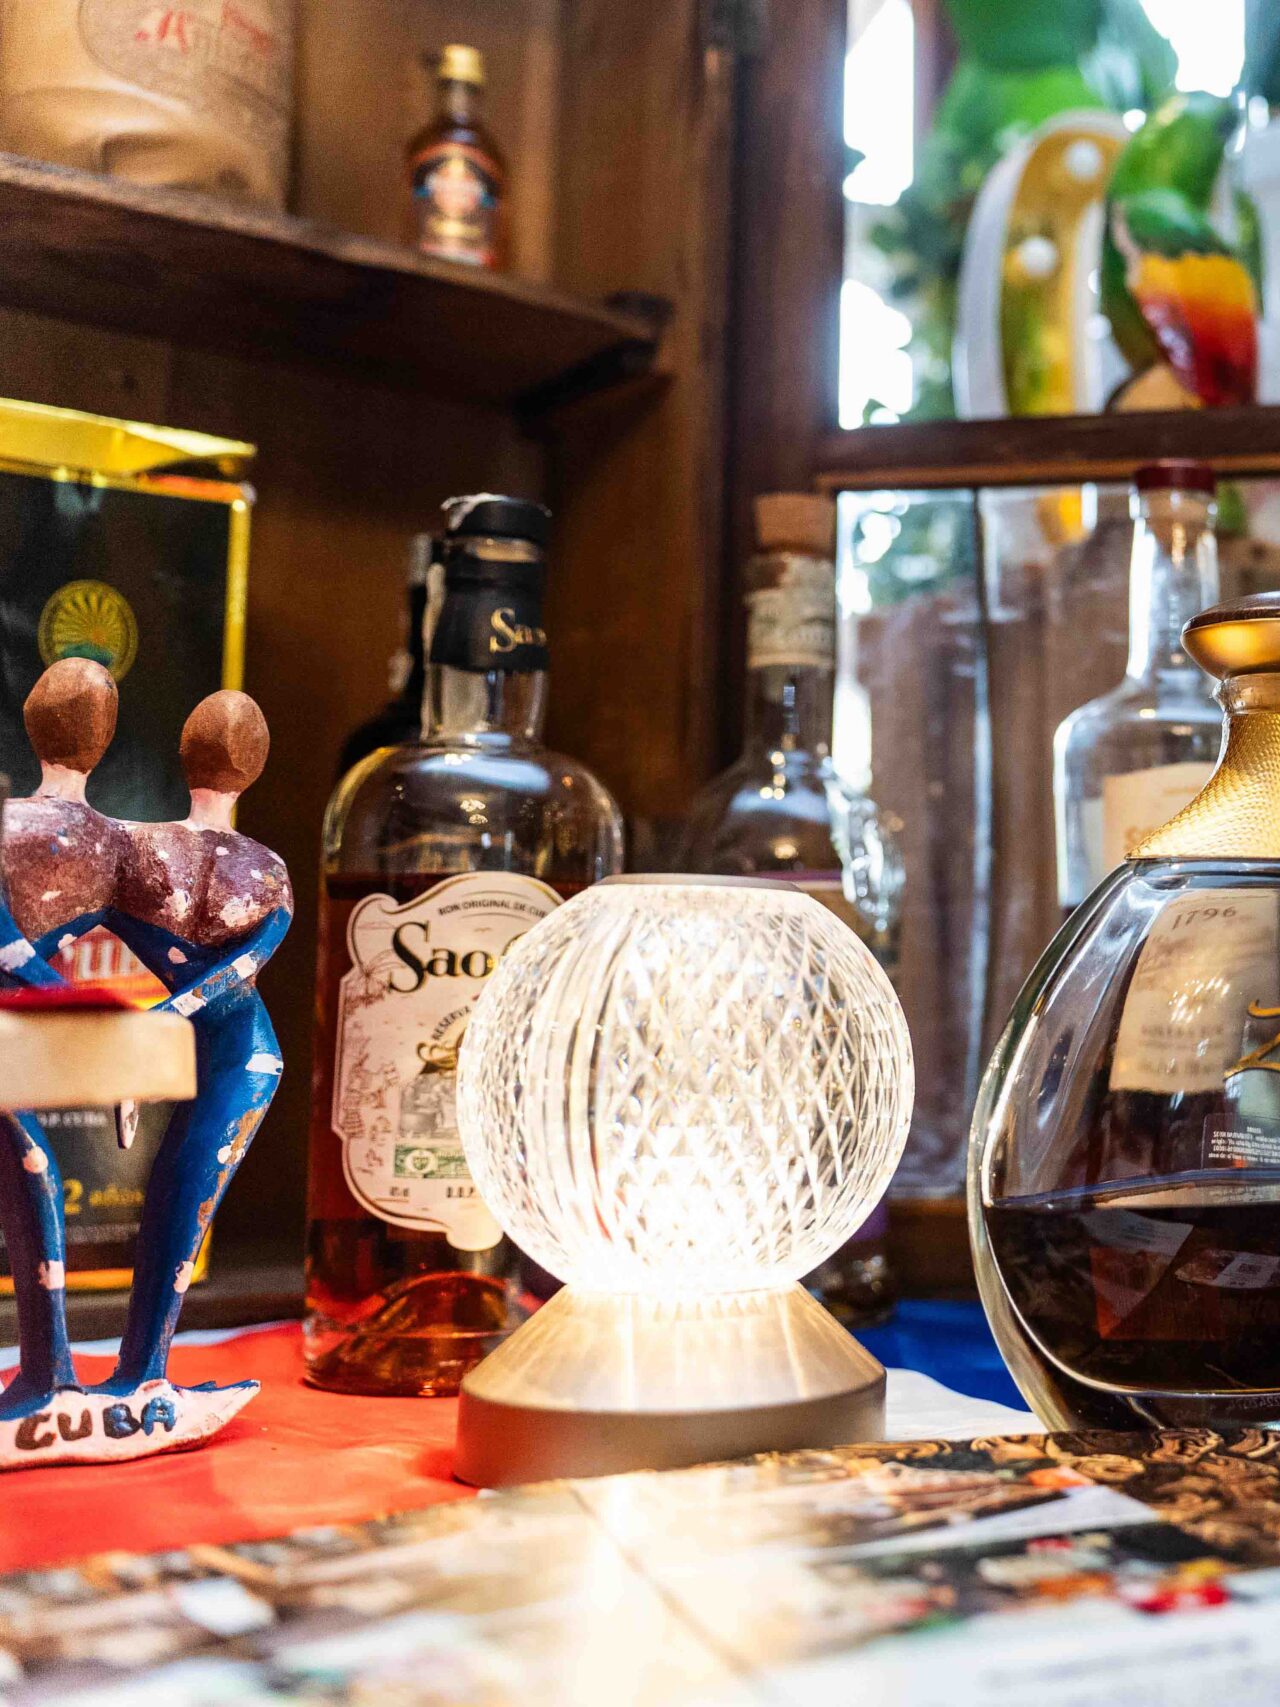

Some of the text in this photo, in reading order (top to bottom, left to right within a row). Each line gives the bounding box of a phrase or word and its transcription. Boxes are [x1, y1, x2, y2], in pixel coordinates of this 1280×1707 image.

[462, 899, 510, 911] ORIGINAL
[513, 902, 526, 912] DE
[529, 906, 549, 918] CUB
[1172, 906, 1238, 930] 1796
[388, 920, 494, 993] Sao
[430, 1005, 472, 1041] RESERVA
[15, 1397, 177, 1451] CUBA
